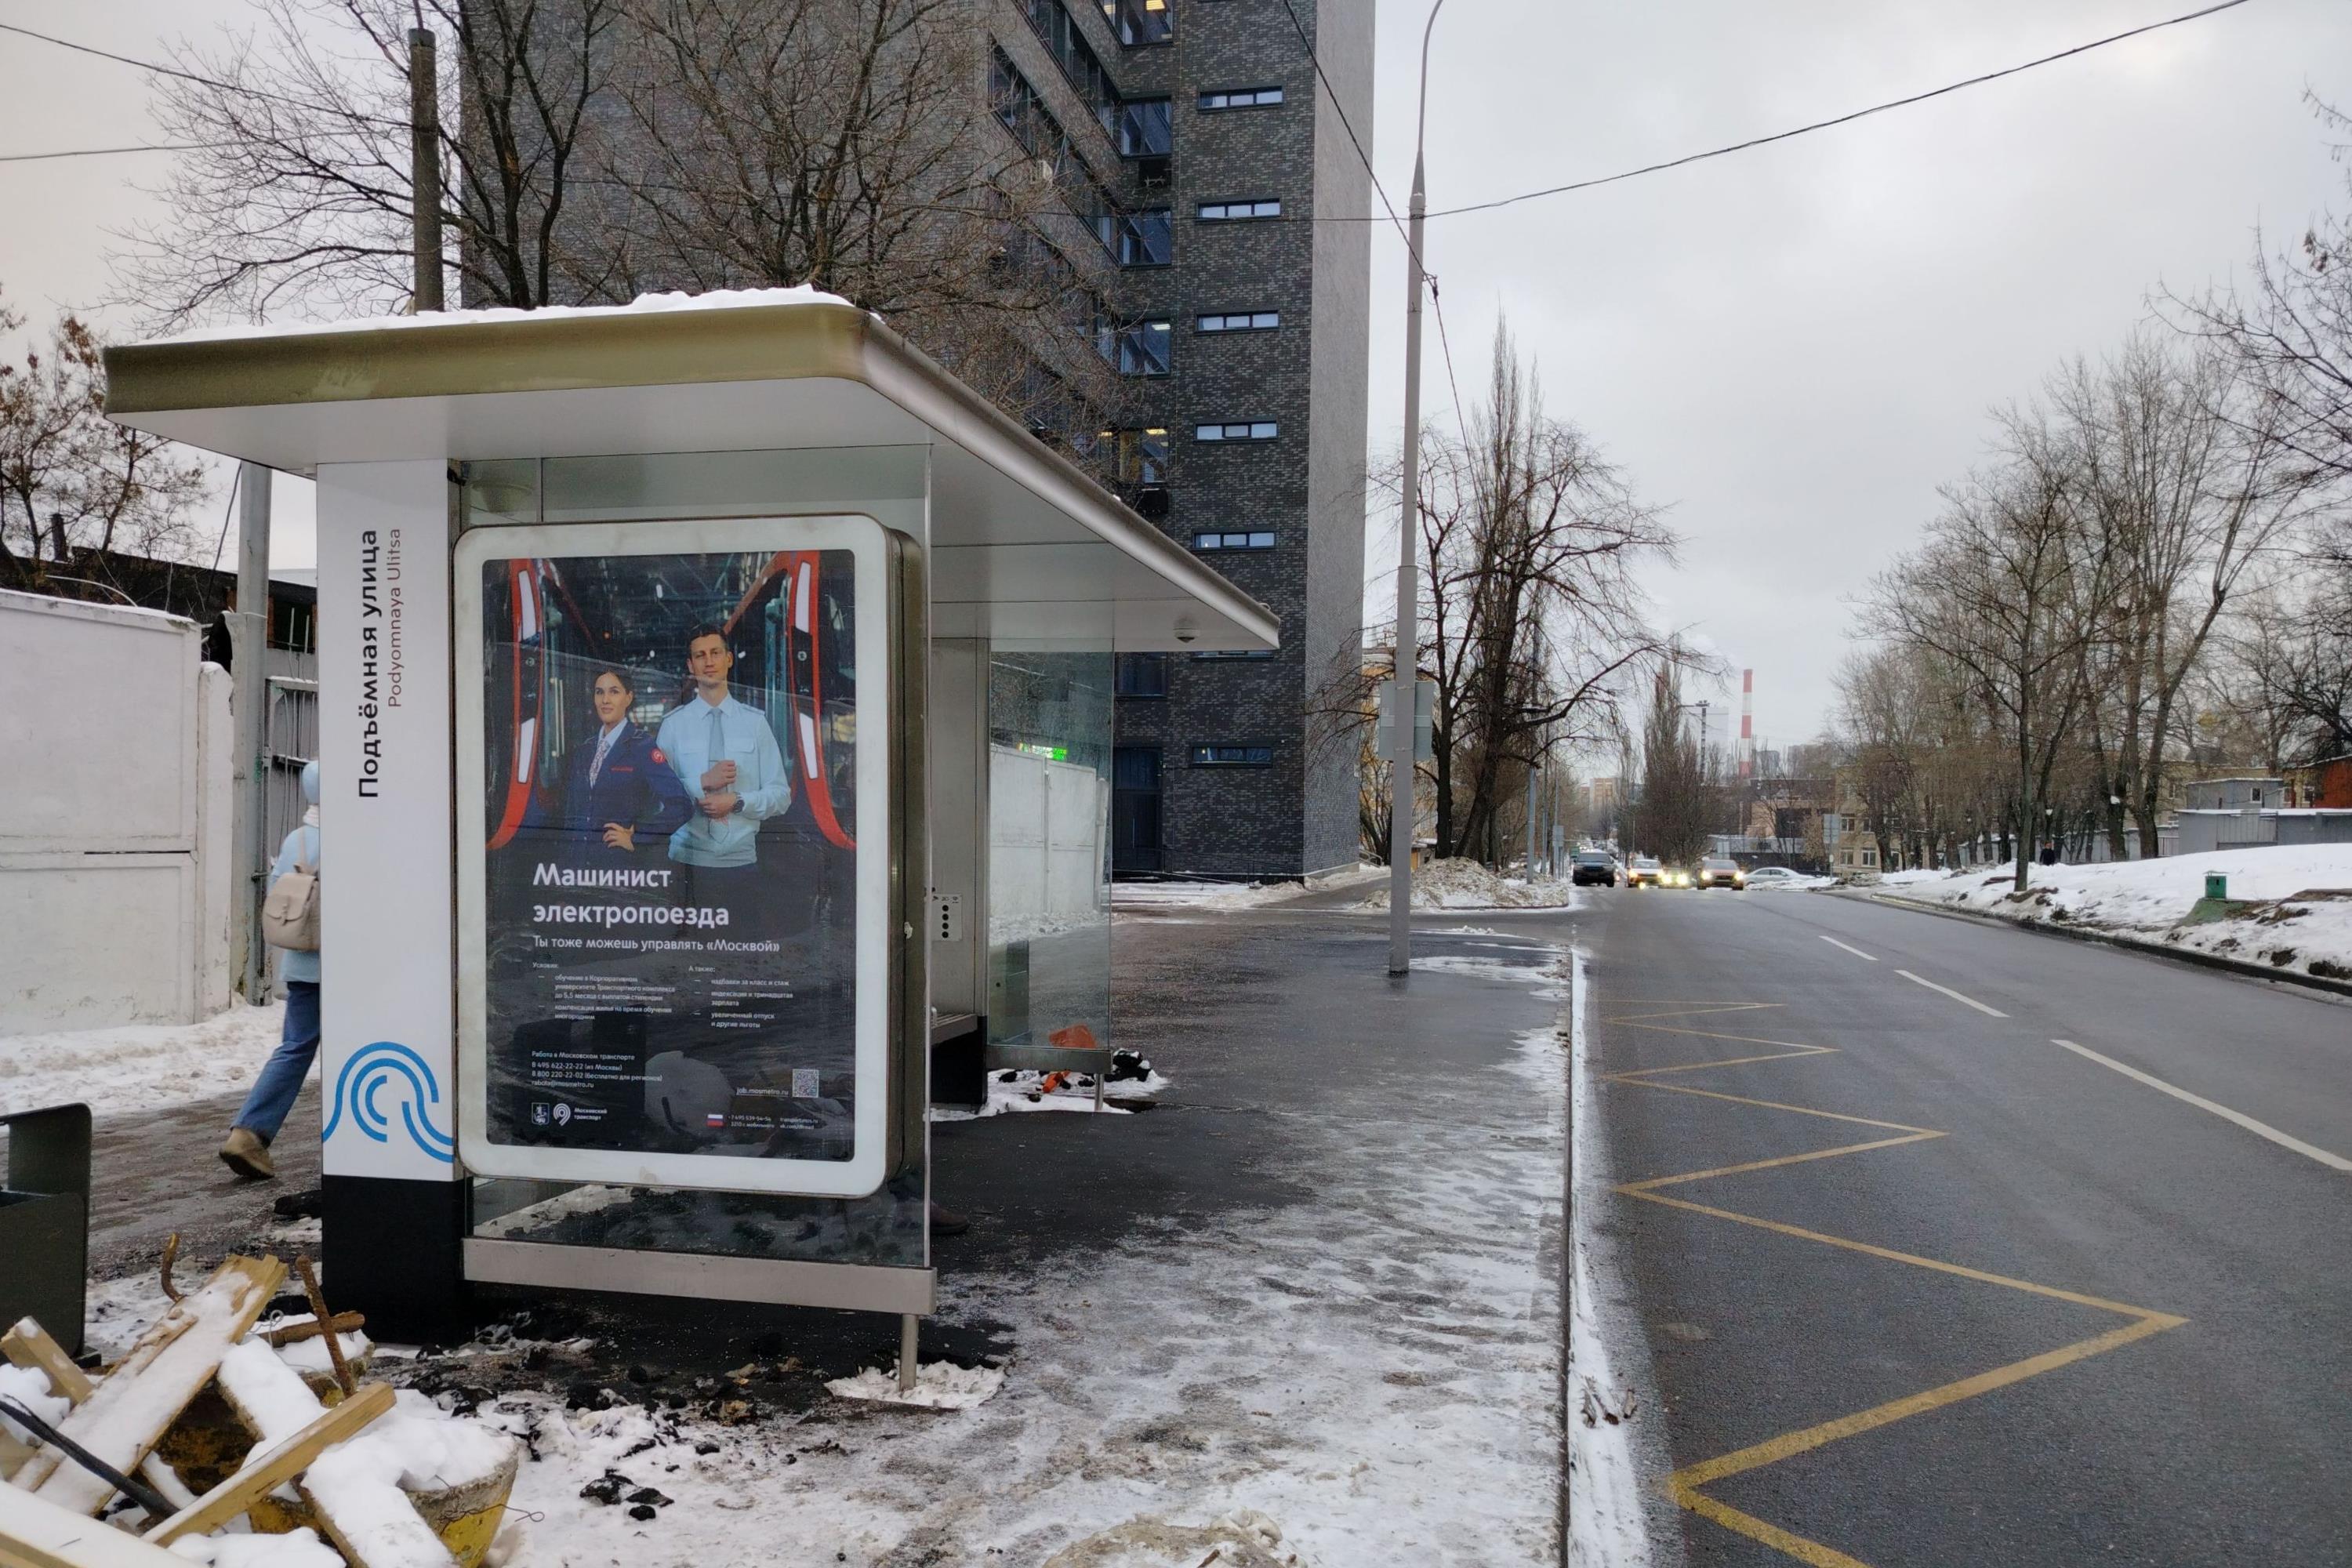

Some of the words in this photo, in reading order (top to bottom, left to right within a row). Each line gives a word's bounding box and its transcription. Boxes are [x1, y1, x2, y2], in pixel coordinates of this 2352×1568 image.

[361, 530, 383, 618] улица
[387, 528, 401, 580] Ulitsa
[388, 588, 405, 707] Podyomnaya
[358, 626, 382, 797] Подъёмная
[533, 862, 672, 887] Машинист
[533, 905, 730, 928] электропоезда
[533, 935, 549, 948] Ты
[551, 938, 583, 948] тоже
[586, 939, 639, 949] можешь
[640, 940, 704, 952] управлять
[706, 939, 780, 953] «Москвой»
